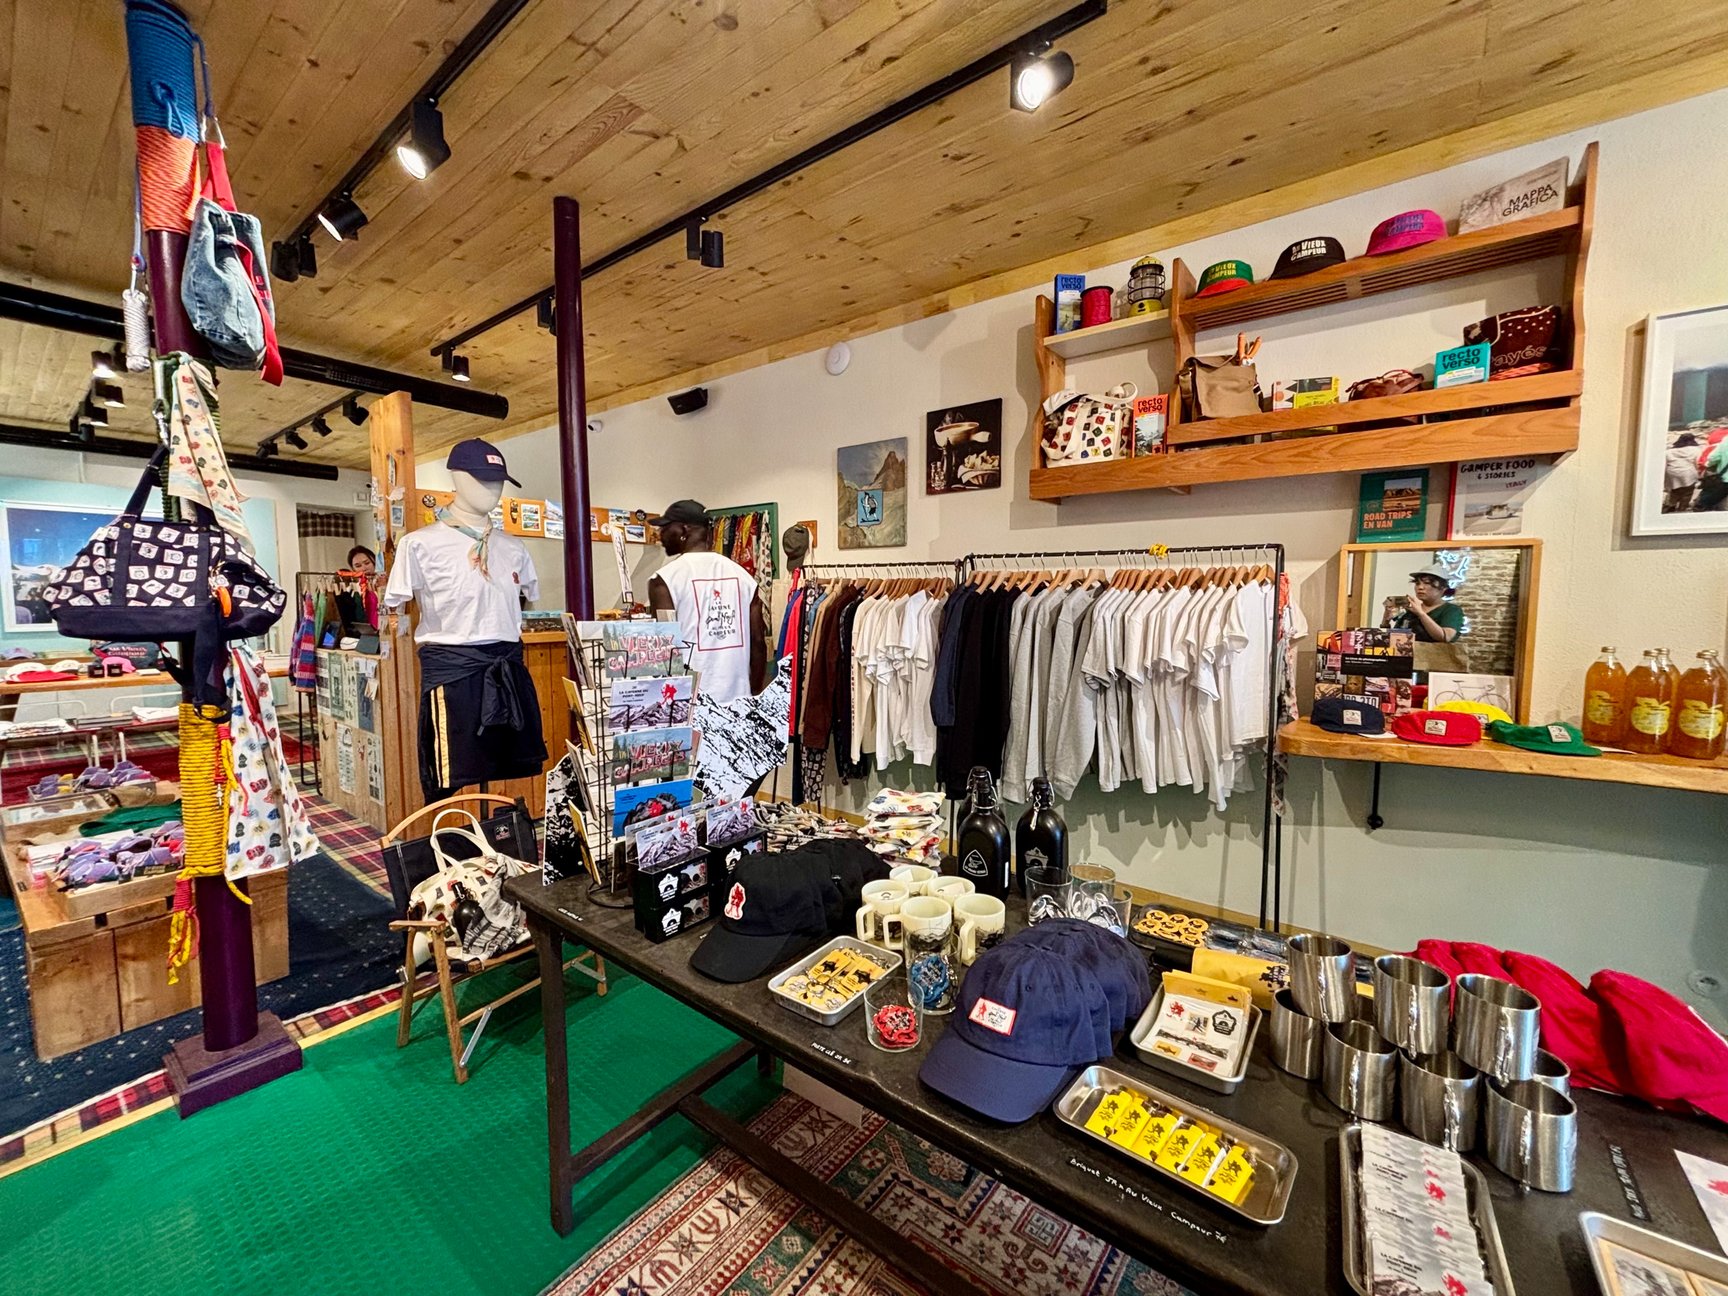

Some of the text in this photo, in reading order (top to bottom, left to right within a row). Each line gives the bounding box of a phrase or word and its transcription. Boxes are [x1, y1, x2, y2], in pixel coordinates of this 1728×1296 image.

[1509, 184, 1553, 207] MAPPA
[1502, 190, 1559, 217] GRAFICA
[1301, 240, 1327, 250] VIEUX
[1290, 247, 1328, 262] CAMPEUR
[1061, 276, 1083, 284] recto
[1442, 348, 1481, 362] recto
[1442, 357, 1481, 370] verso
[1137, 398, 1163, 408] recto
[1137, 405, 1163, 413] verso
[1505, 459, 1535, 470] FOOD
[1484, 471, 1516, 479] STORIES
[1505, 479, 1529, 488] ITALY
[1363, 510, 1413, 521] ROAD TRIPS
[1363, 521, 1375, 529] EN
[1376, 520, 1393, 528] VAN
[1070, 1158, 1101, 1178] Briquet
[1105, 1175, 1118, 1187] JR
[1141, 1194, 1163, 1211] Vieux
[1170, 1211, 1213, 1236] Campeur
